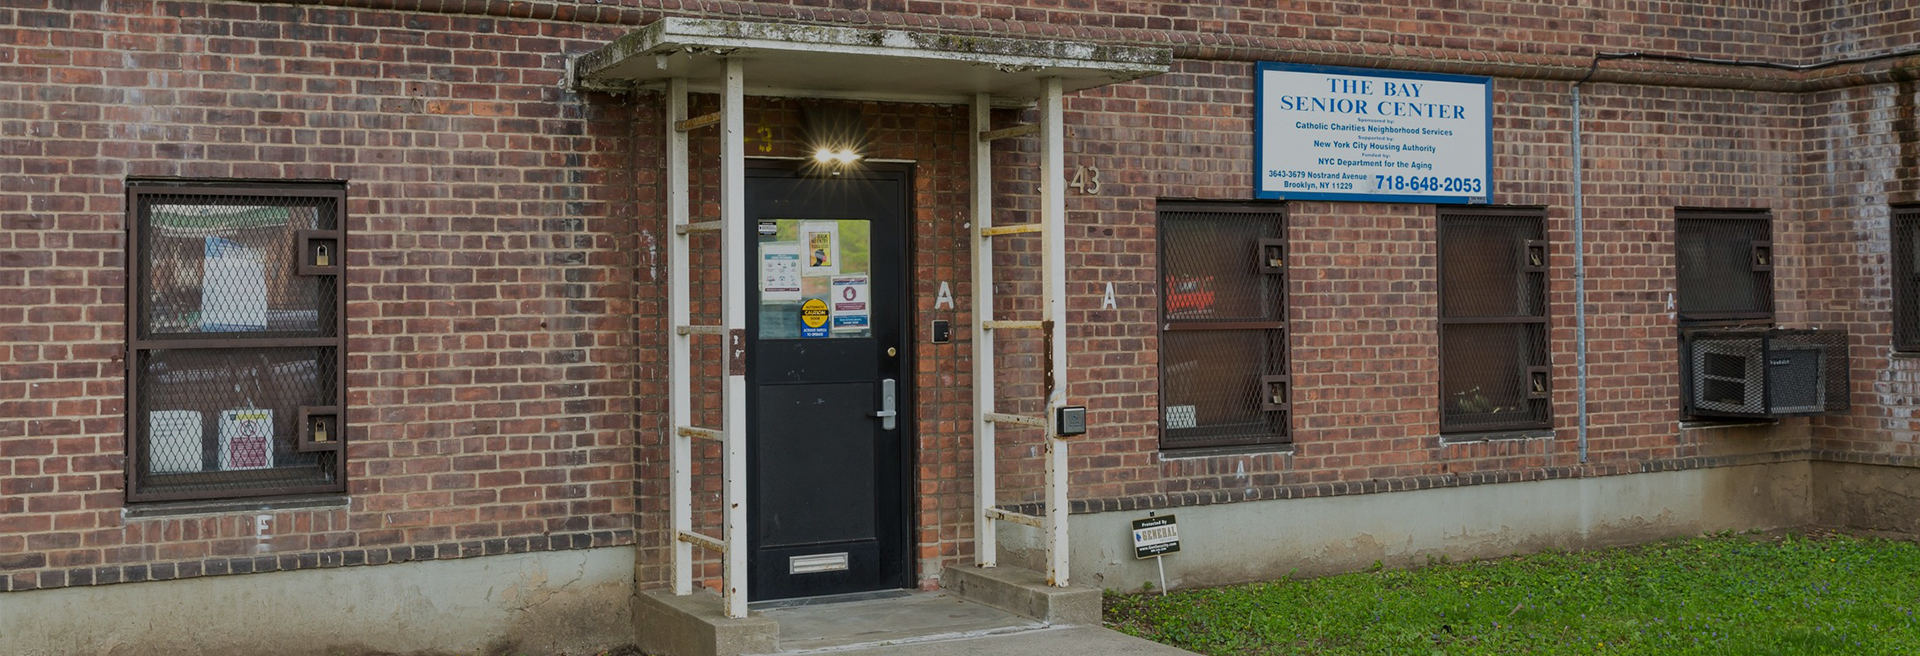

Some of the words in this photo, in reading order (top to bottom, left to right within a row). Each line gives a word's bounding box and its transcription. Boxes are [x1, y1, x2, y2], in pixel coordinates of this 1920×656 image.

[1326, 77, 1374, 96] THE
[1384, 81, 1424, 98] BAY
[1280, 95, 1368, 115] SENIOR
[1377, 100, 1466, 120] CENTER
[1295, 121, 1329, 131] Catholic
[1330, 122, 1366, 132] Charities
[1367, 124, 1420, 135] Neighborhood
[1421, 127, 1453, 136] Services
[1313, 140, 1331, 148] New
[1333, 140, 1351, 149] York
[1352, 141, 1368, 150] City
[1369, 142, 1401, 152] Housing
[1402, 144, 1437, 153] Authority
[1318, 157, 1335, 166] NYC
[1336, 158, 1382, 168] Department
[1384, 160, 1395, 168] for
[1396, 161, 1410, 169] the
[1411, 161, 1433, 171] Aging
[1268, 169, 1306, 178] 3643-3679
[1307, 171, 1341, 180] Nostrand
[1341, 172, 1368, 181] Avenue
[1283, 180, 1318, 190] Brooklyn,
[1319, 181, 1330, 189] NY
[1332, 182, 1353, 190] 11229
[1375, 174, 1482, 193] 718-648-2053
[934, 281, 954, 309] A
[1102, 281, 1118, 310] A
[1142, 525, 1177, 541] GENERAL
